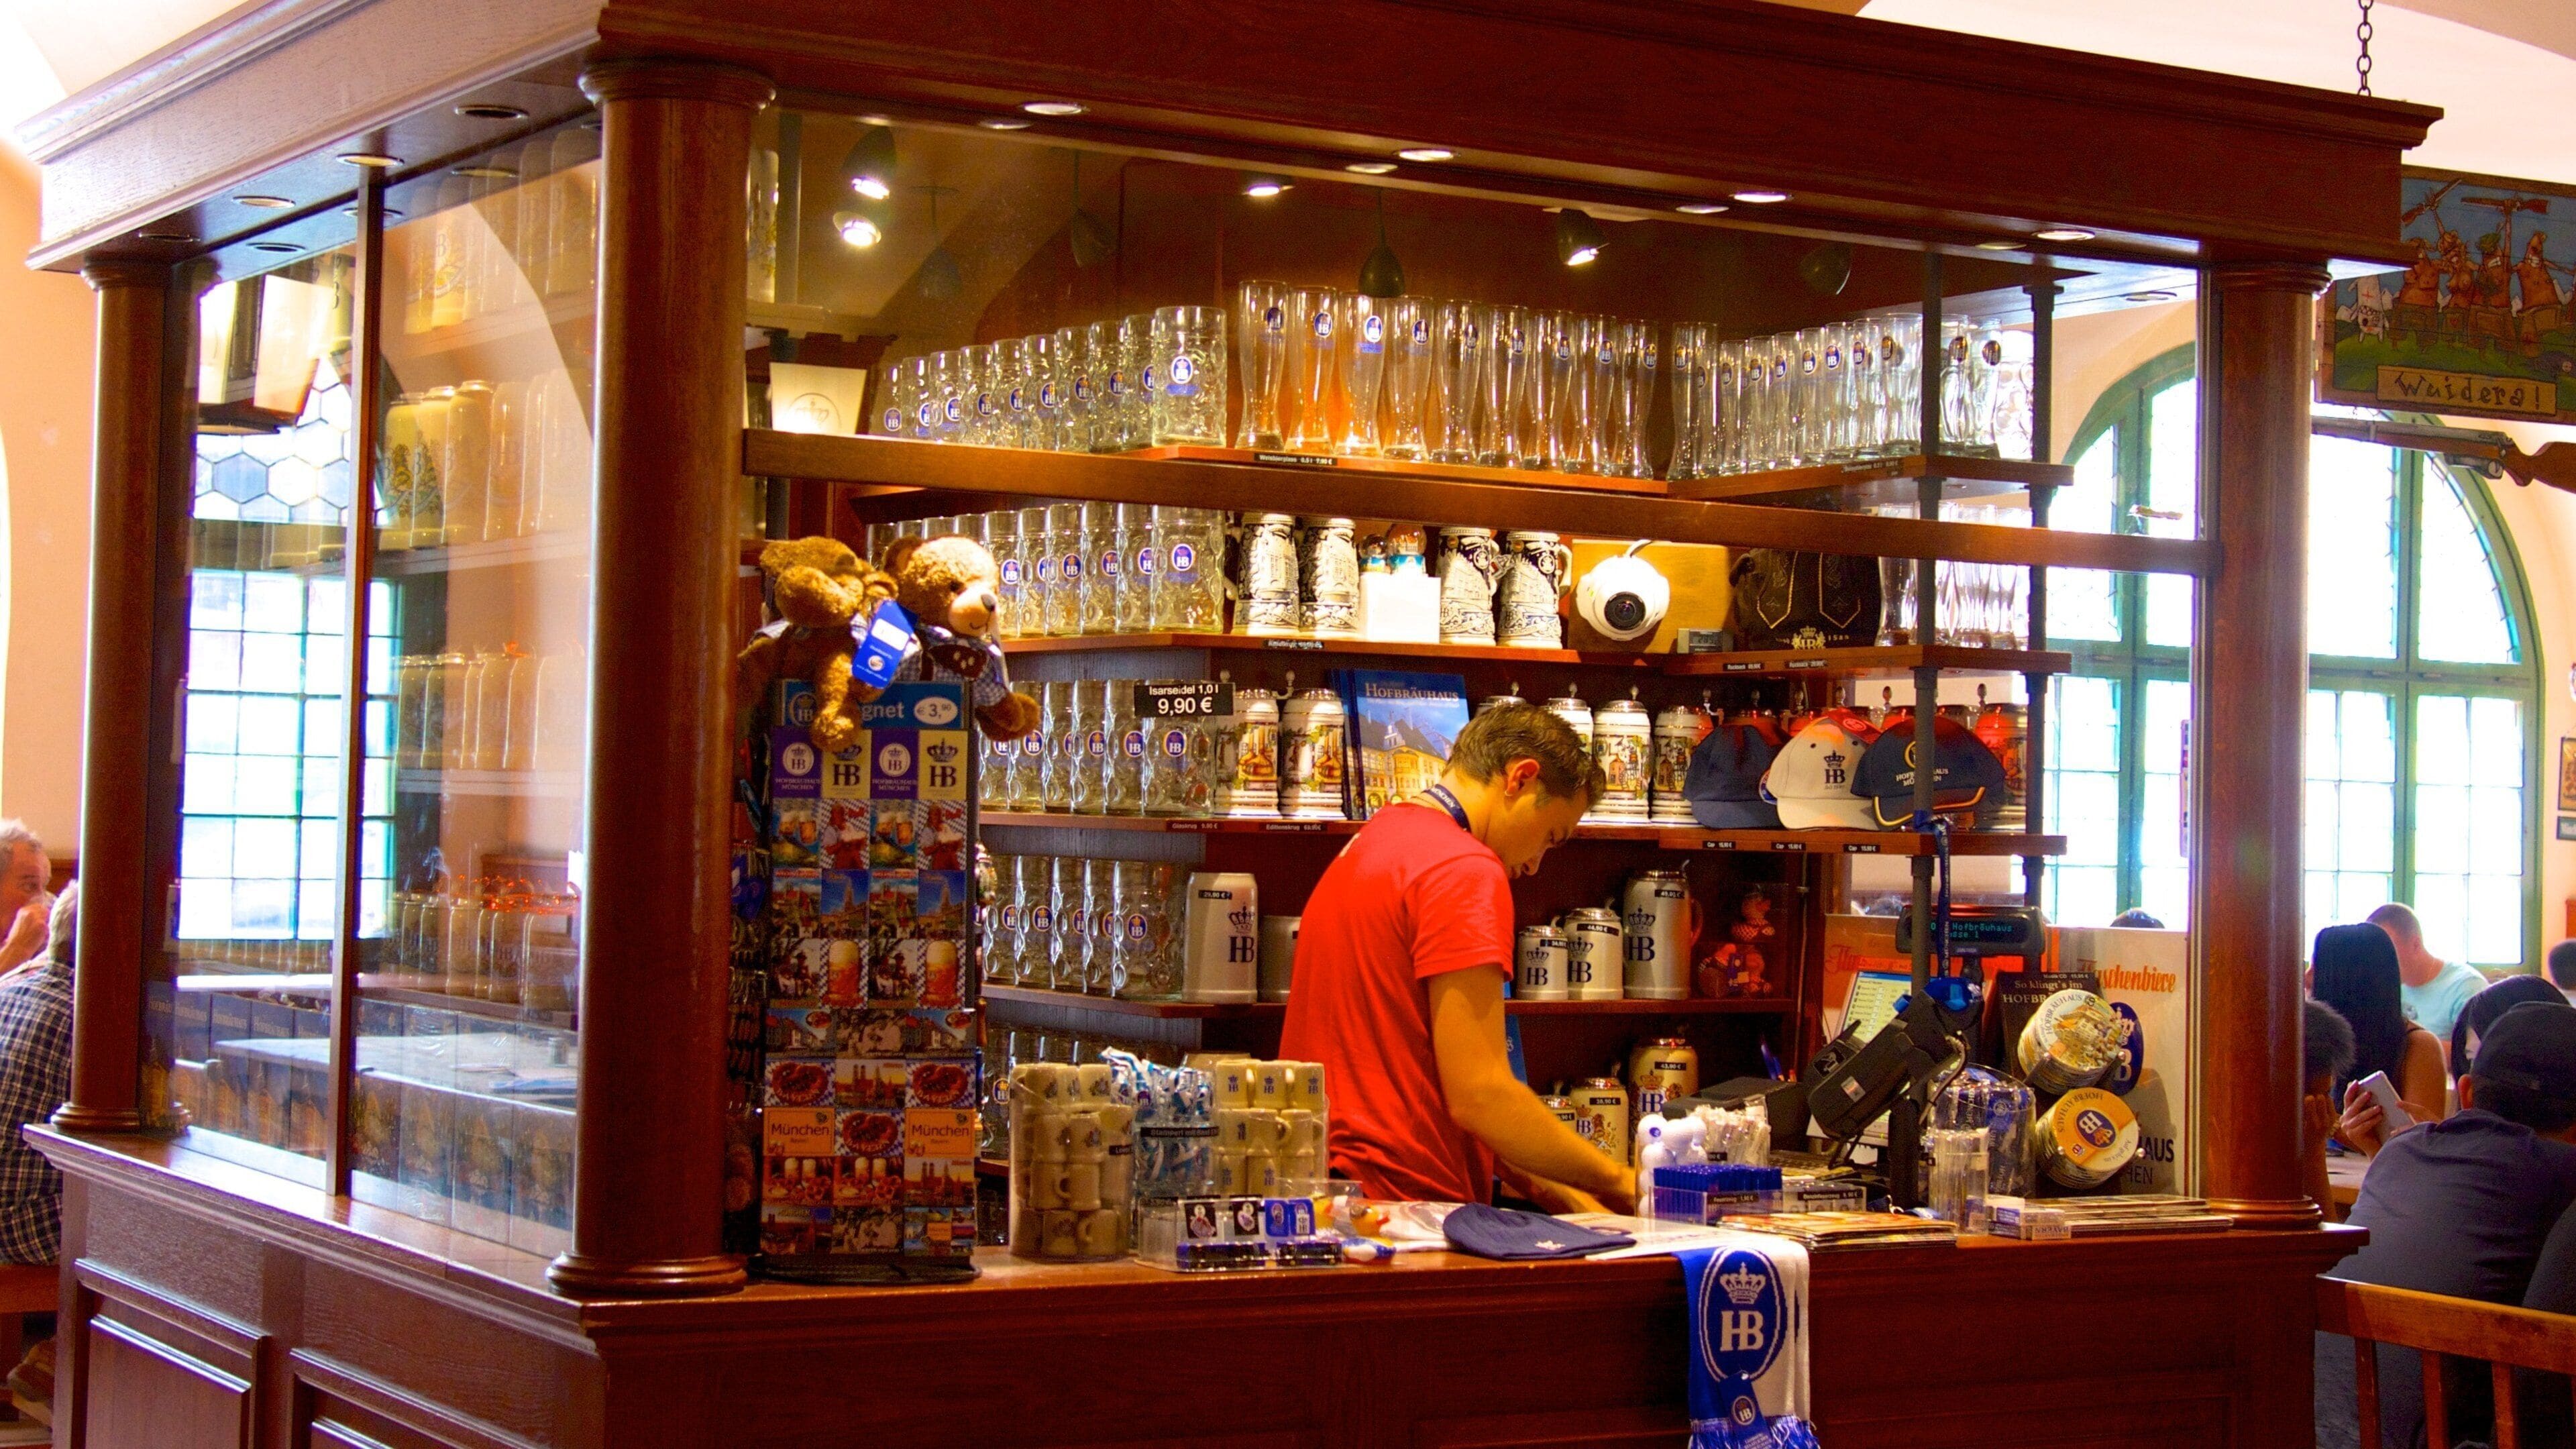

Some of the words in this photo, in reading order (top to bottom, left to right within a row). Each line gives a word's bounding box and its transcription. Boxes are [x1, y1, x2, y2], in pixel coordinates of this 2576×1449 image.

[1149, 685, 1195, 695] Isarseidel
[1199, 684, 1212, 696] 1,0
[1365, 682, 1460, 702] HOFBRÄUHAUS
[862, 702, 905, 721] gnet
[1158, 698, 1195, 716] 9,90
[1200, 698, 1213, 713] €
[833, 763, 861, 786] HB
[928, 765, 957, 788] HB
[1825, 768, 1845, 784] HB
[1896, 768, 1949, 782] HOFBAUS
[1228, 936, 1255, 963] HB
[1628, 936, 1656, 962] HB
[1526, 967, 1548, 986] HB
[1568, 961, 1592, 983] HB
[2015, 980, 2027, 989] So
[2070, 981, 2083, 989] im
[2002, 993, 2051, 1004] HOFBR
[2045, 994, 2083, 1036] HOFBRÄUHAUS
[1642, 1093, 1664, 1113] HB
[771, 1124, 830, 1136] München
[912, 1124, 969, 1137] München
[1576, 1119, 1592, 1134] HB
[2080, 1112, 2103, 1134] HB
[2139, 1136, 2174, 1163] AUS
[1719, 1310, 1765, 1352] HB
